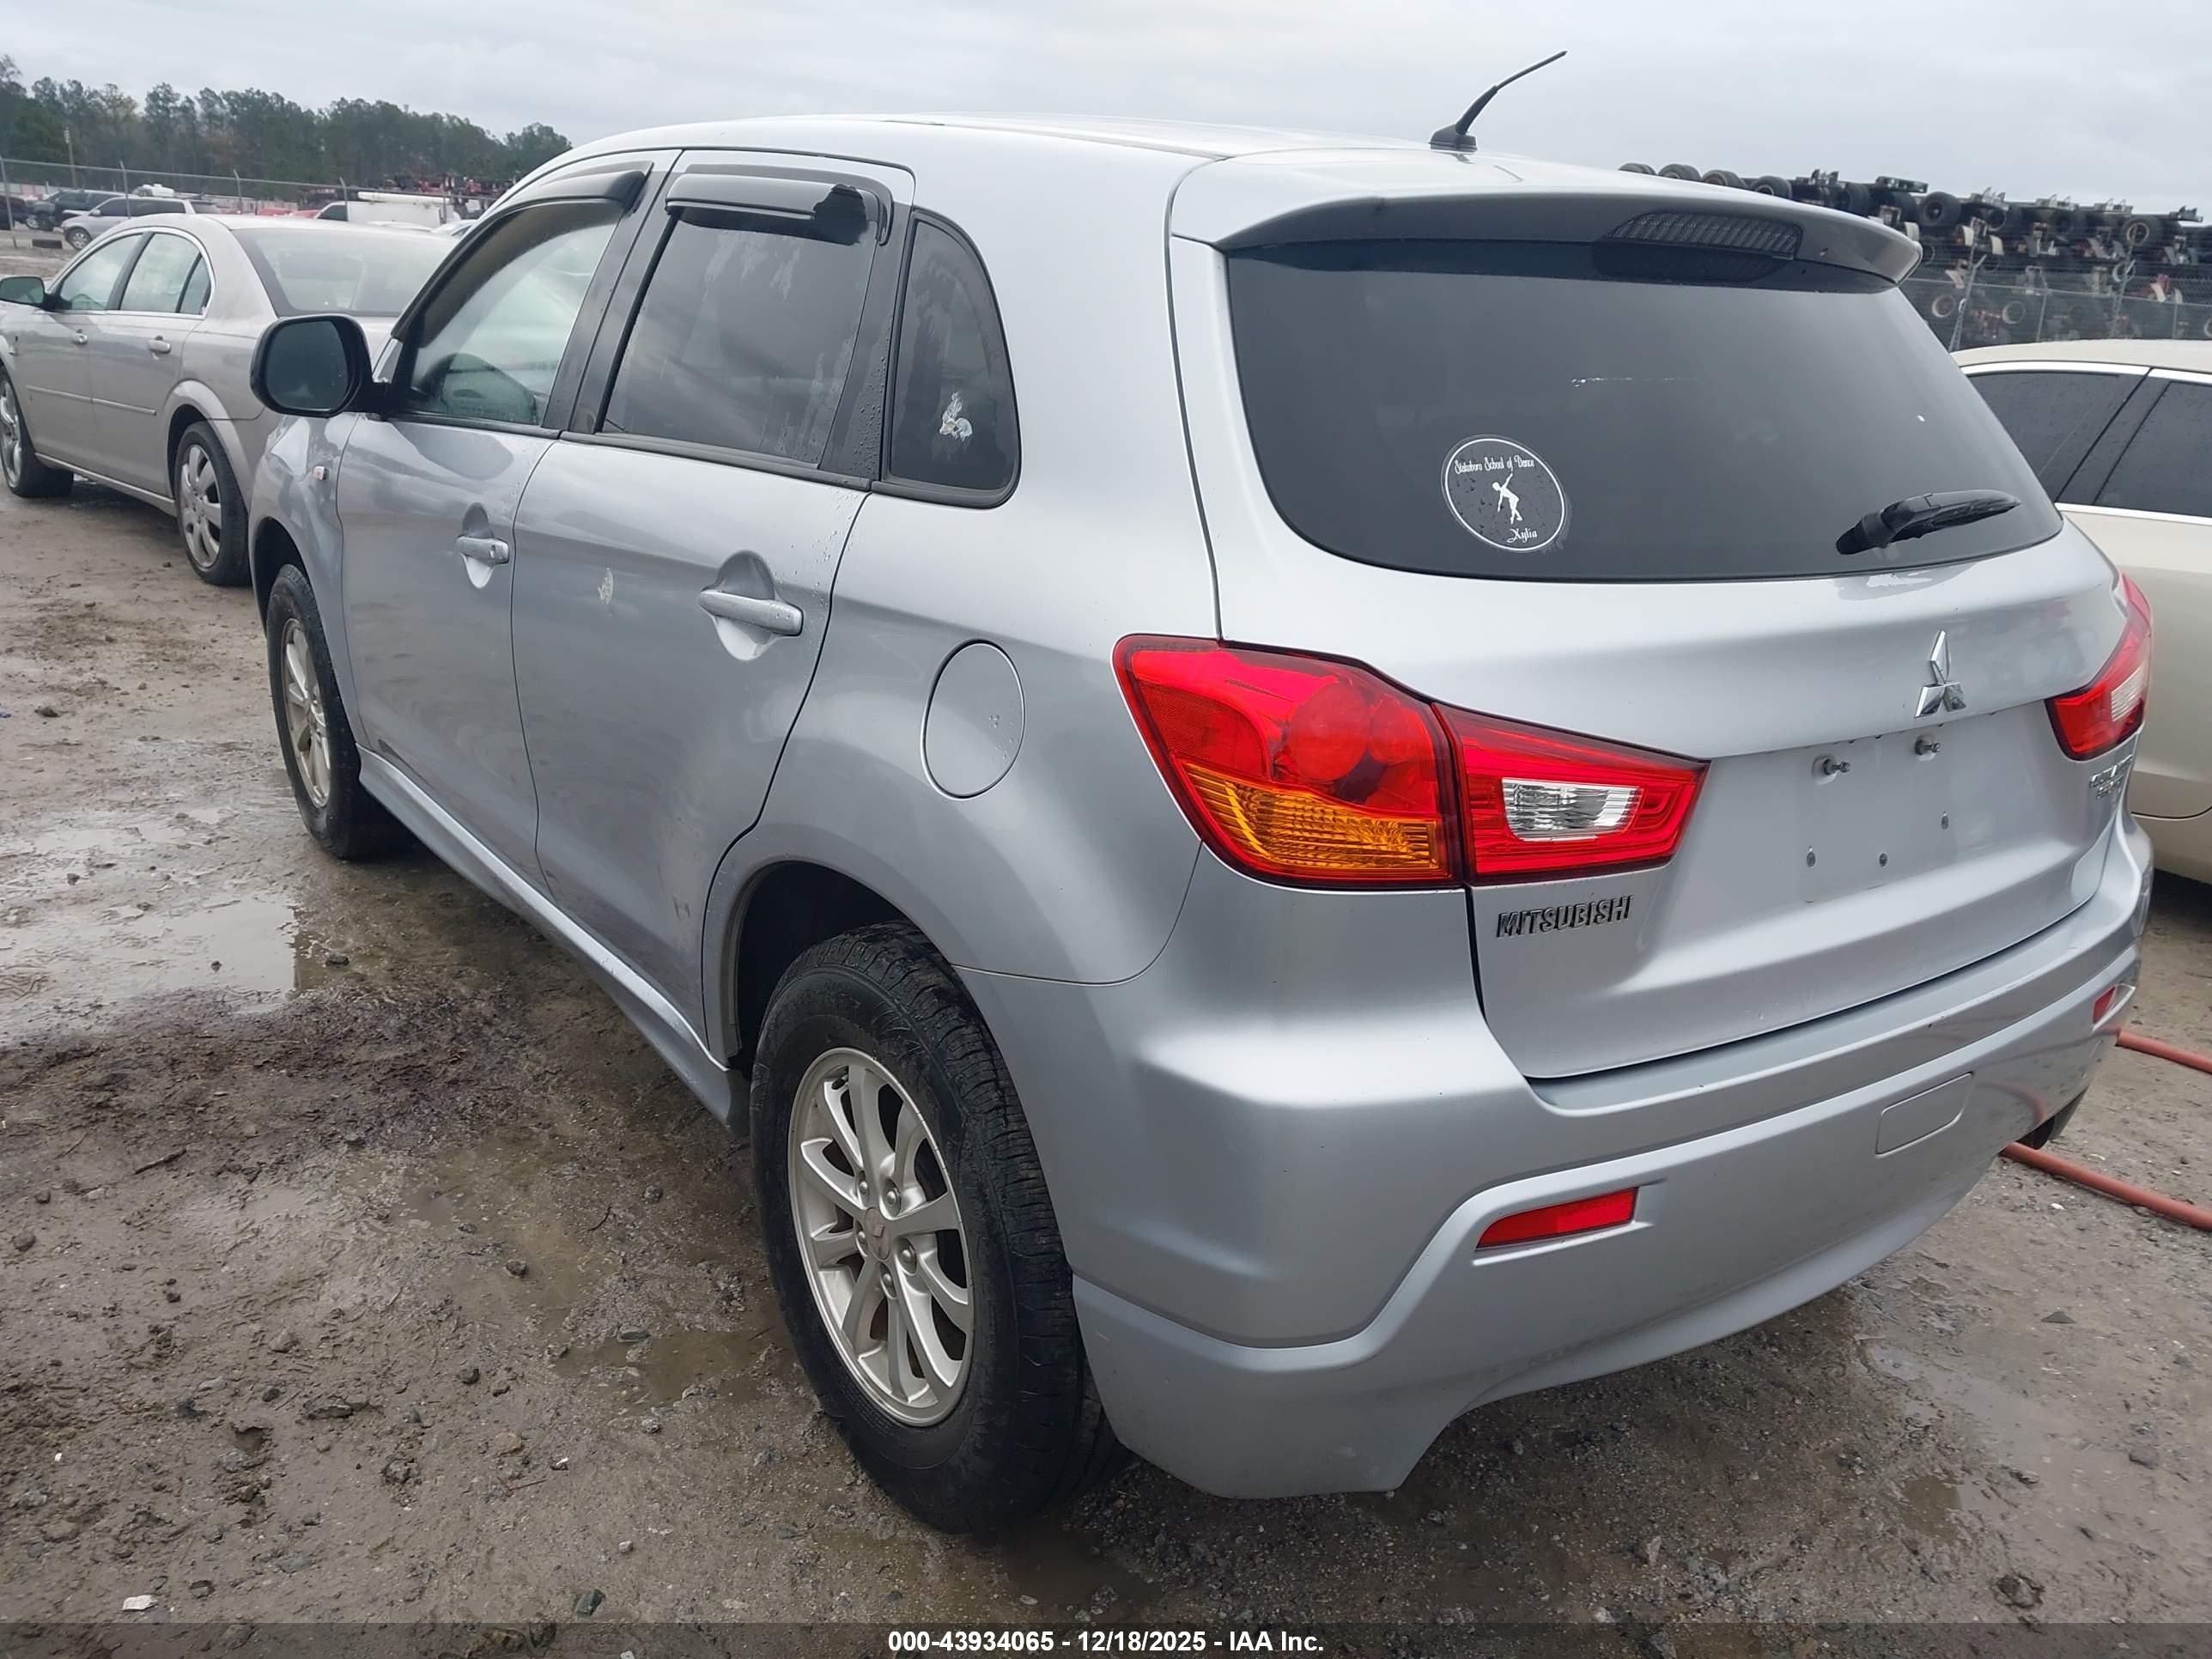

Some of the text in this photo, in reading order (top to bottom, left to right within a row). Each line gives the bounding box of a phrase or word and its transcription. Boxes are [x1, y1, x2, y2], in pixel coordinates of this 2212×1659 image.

[1485, 457, 1504, 471] School
[1507, 457, 1513, 471] of
[1514, 455, 1534, 467] Dance
[1496, 896, 1632, 938] MITSUBISHI
